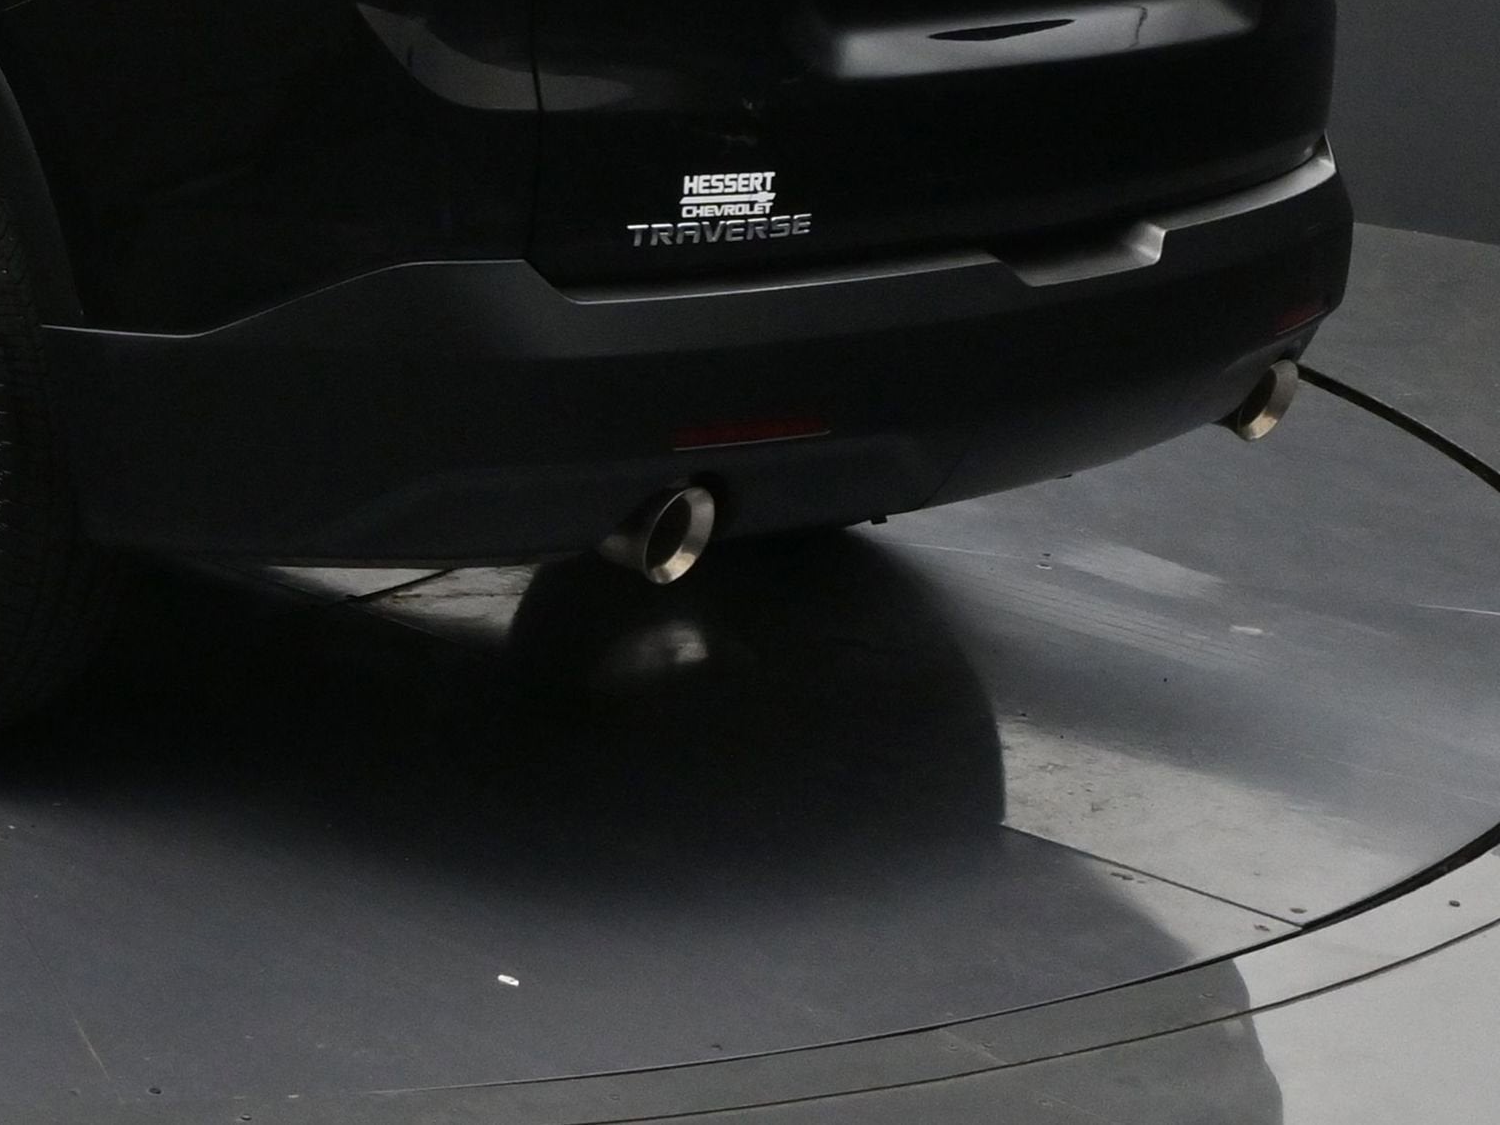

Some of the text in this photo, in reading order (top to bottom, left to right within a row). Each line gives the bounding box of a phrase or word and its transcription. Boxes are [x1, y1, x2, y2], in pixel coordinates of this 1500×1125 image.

[683, 171, 776, 195] HESSERT
[681, 202, 774, 218] CHEVROLET
[626, 213, 812, 247] TRAVERSE
